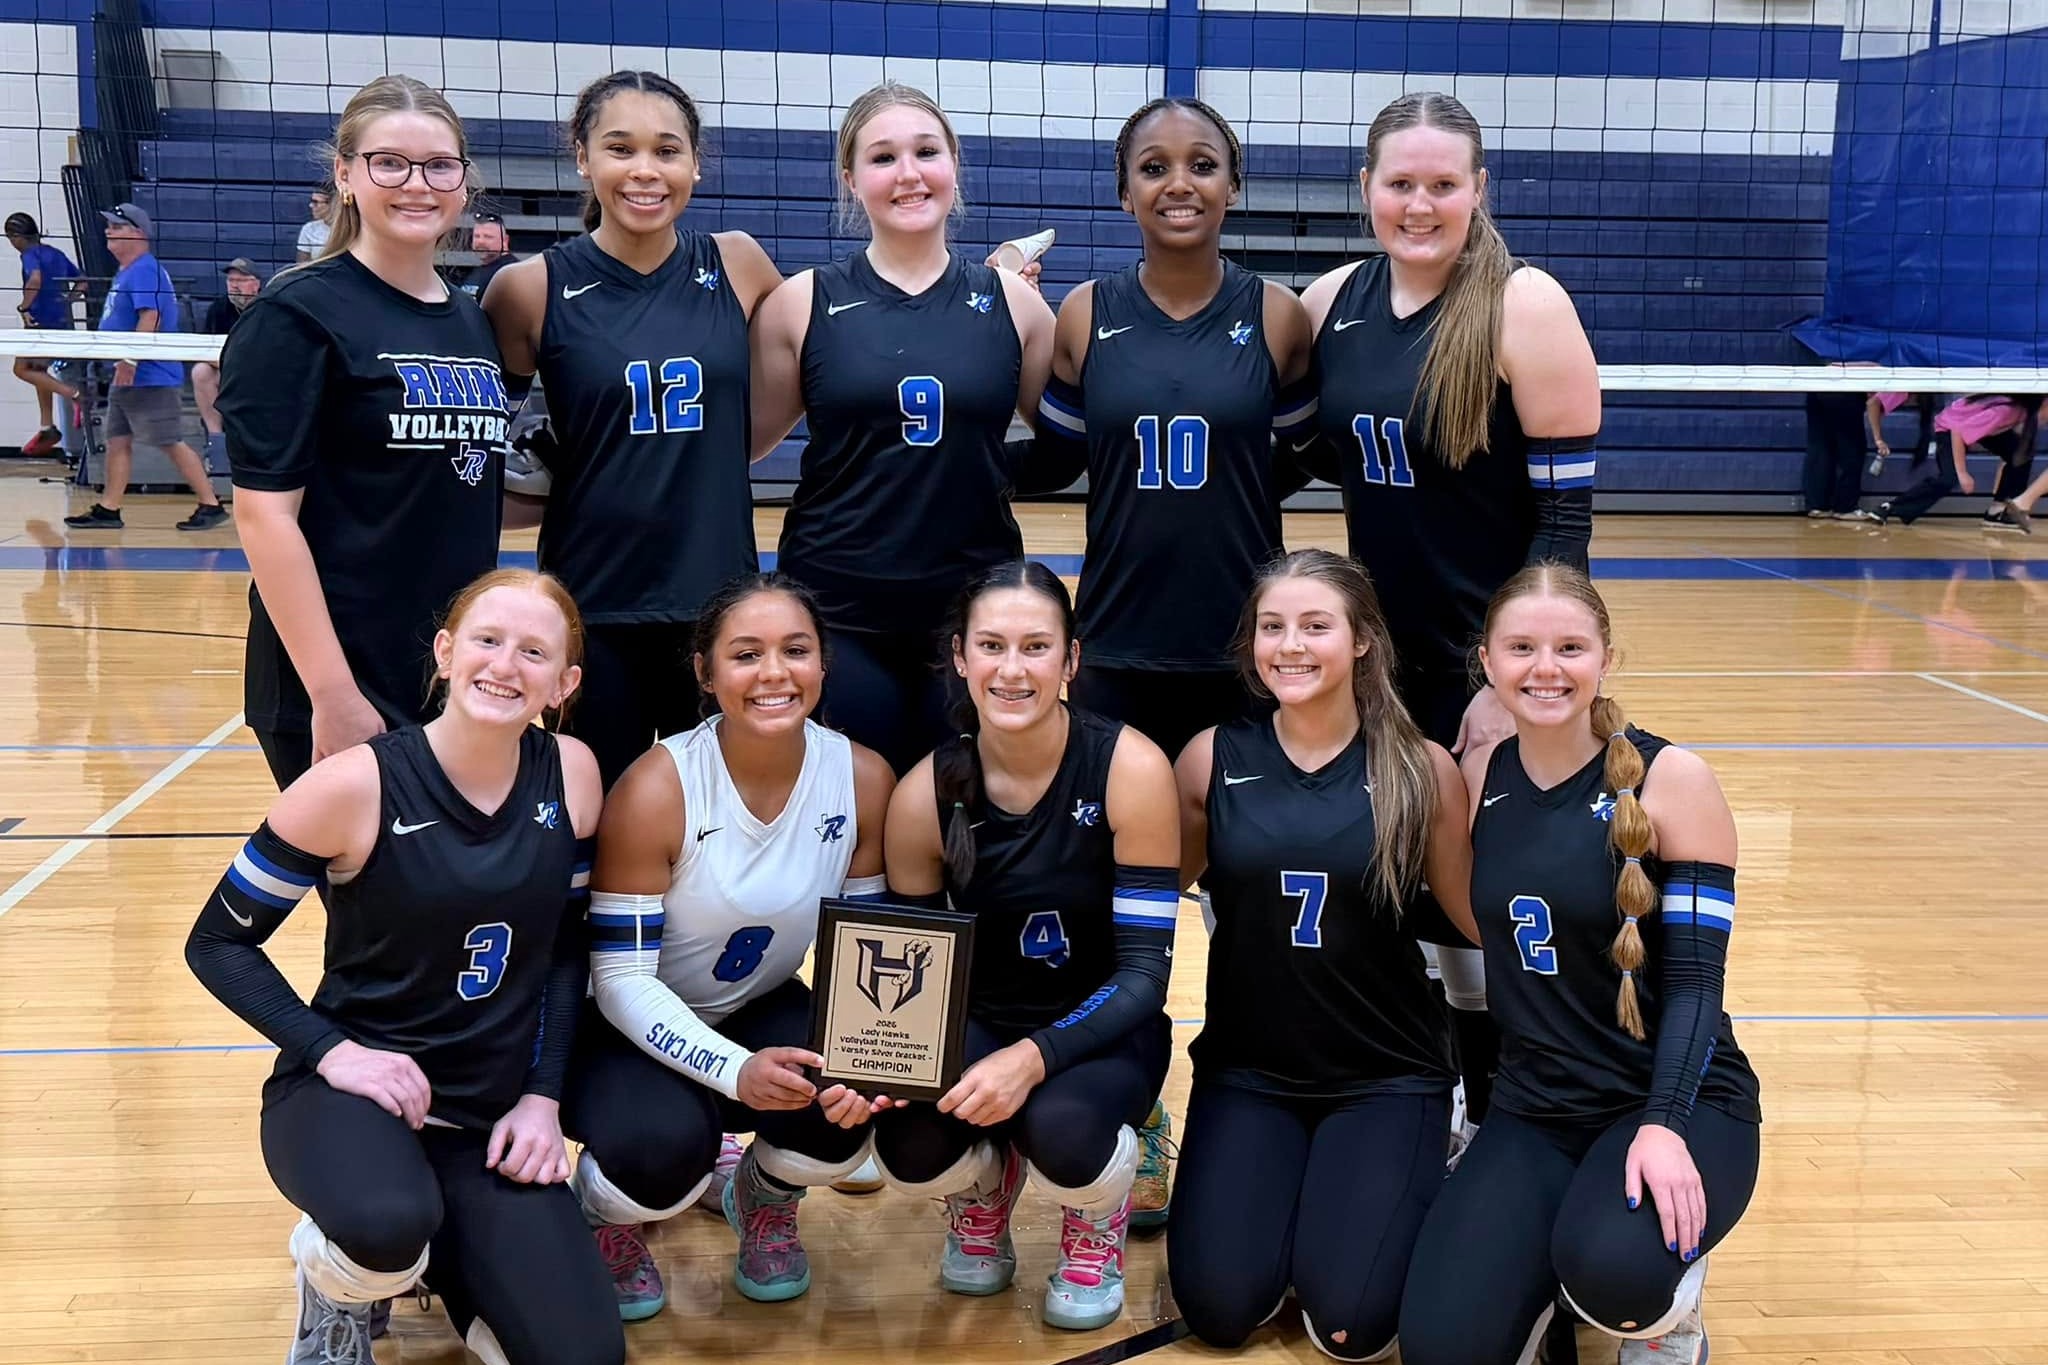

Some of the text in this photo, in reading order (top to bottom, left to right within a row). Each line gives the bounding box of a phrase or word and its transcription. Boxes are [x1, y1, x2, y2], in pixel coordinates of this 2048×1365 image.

[625, 356, 704, 435] 12
[897, 375, 944, 447] 9
[388, 413, 510, 442] VOLLEYBA
[1134, 415, 1210, 490] 10
[1352, 413, 1416, 488] 11
[822, 814, 847, 843] R
[1280, 870, 1329, 949] 7
[1507, 894, 1559, 976] 2
[456, 921, 513, 1002] 3
[711, 925, 775, 983] 8
[1019, 910, 1071, 969] 4
[646, 1022, 728, 1079] LADY CATS
[840, 1035, 929, 1052] Volleyball Tournament
[841, 1045, 869, 1056] Varsity
[871, 1048, 893, 1059] Silver
[895, 1050, 926, 1061] Bracket
[860, 1028, 910, 1040] Lady Hawks
[851, 1058, 912, 1074] CHAMPION
